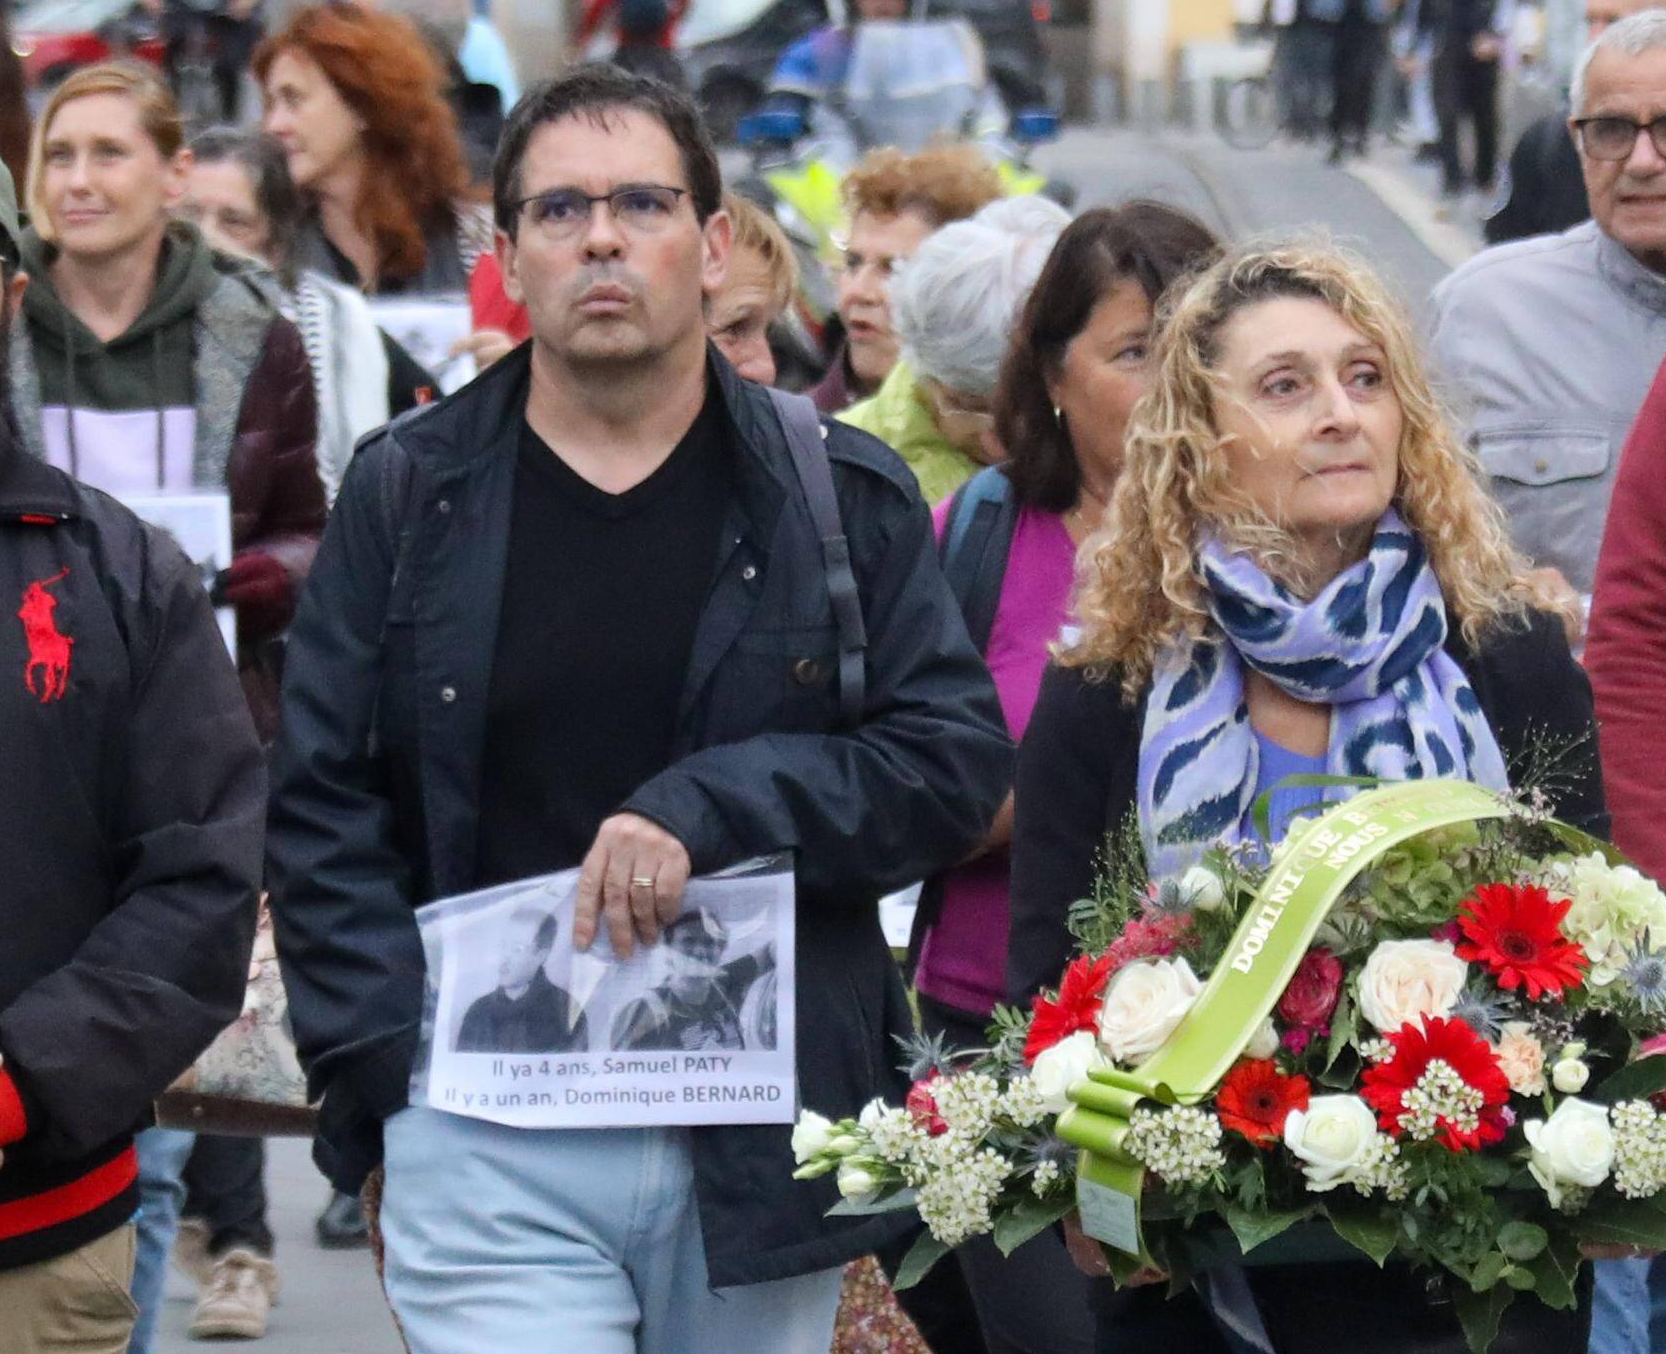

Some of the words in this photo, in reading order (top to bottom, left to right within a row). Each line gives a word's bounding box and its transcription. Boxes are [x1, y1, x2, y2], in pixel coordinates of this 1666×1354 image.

[1324, 822, 1389, 871] NOUS
[493, 1060, 504, 1076] Il
[538, 1060, 551, 1076] 4
[556, 1061, 597, 1078] ans,
[603, 1057, 677, 1075] Samuel
[684, 1056, 732, 1073] PATY
[445, 1088, 457, 1102] Il
[496, 1094, 521, 1107] un
[527, 1093, 558, 1107] an,
[565, 1086, 676, 1107] Dominique
[683, 1085, 781, 1103] BERNARD
